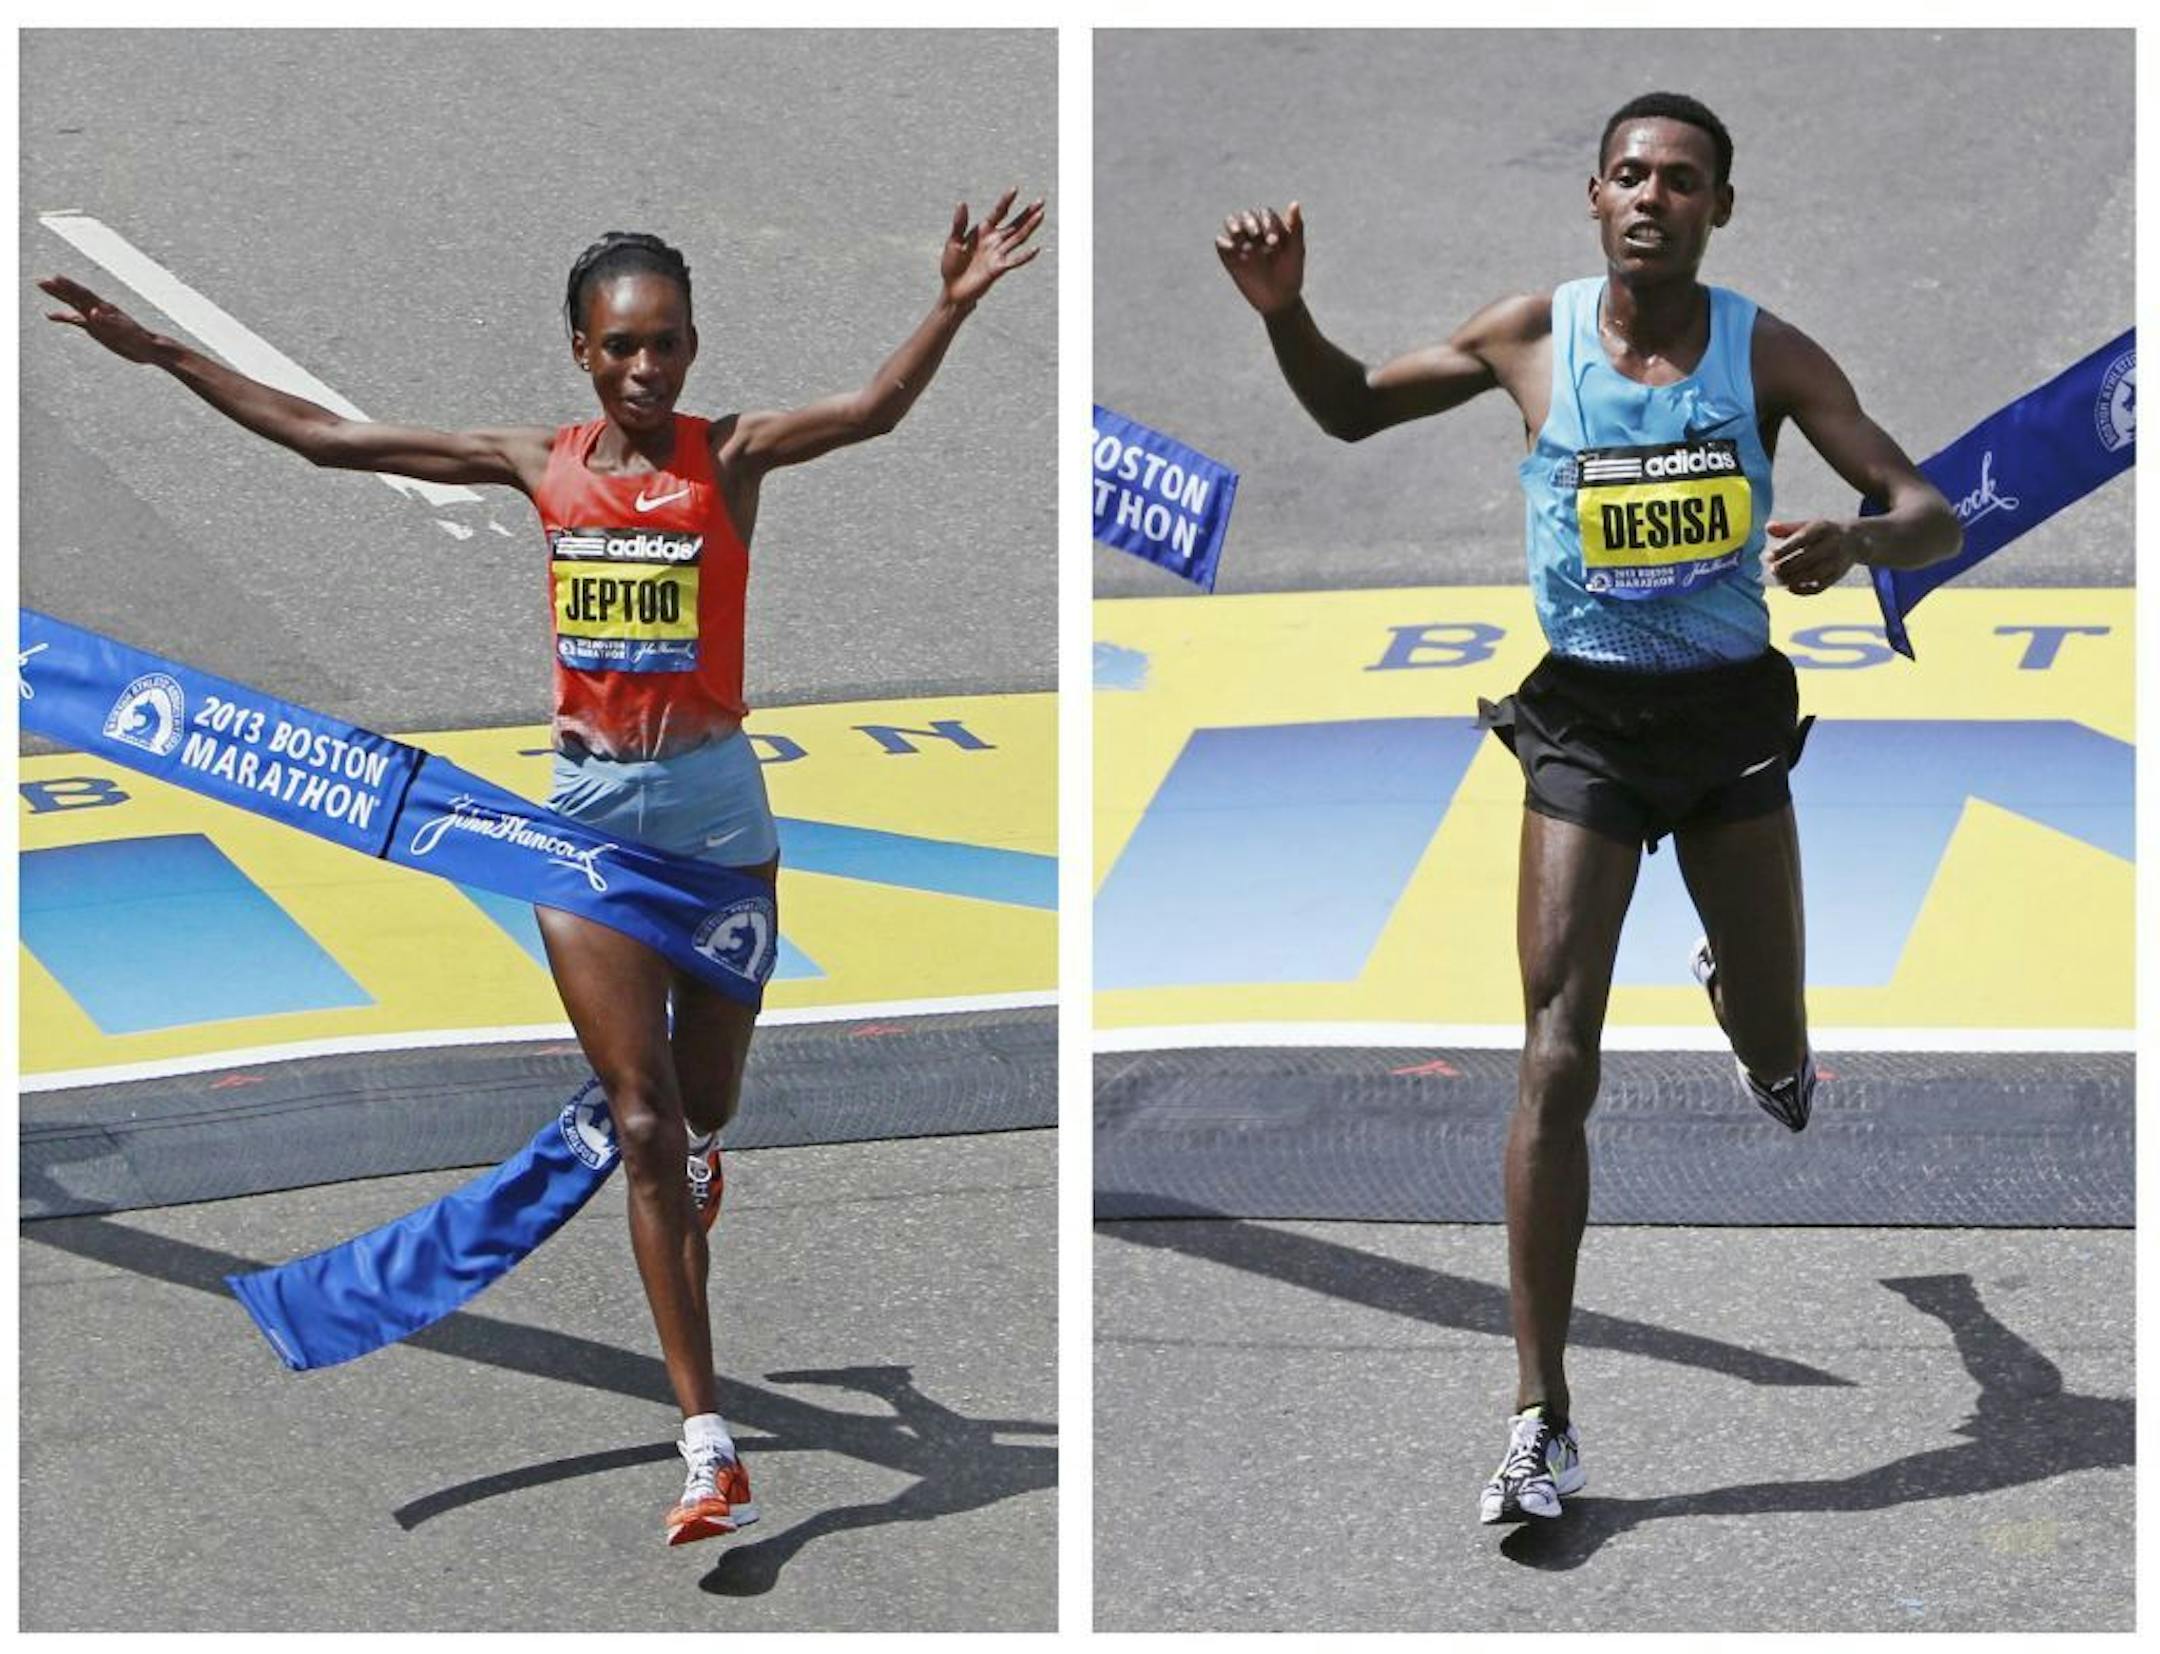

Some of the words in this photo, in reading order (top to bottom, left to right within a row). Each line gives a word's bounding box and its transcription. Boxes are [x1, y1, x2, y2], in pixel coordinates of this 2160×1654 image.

[1645, 447, 1737, 477] adidas
[607, 535, 696, 561] adidas
[1601, 494, 1730, 551] DESISA
[566, 578, 680, 624] JEPTOO
[193, 696, 266, 744] 2013
[268, 720, 389, 788] BOSTON
[181, 732, 373, 829] MARATHON
